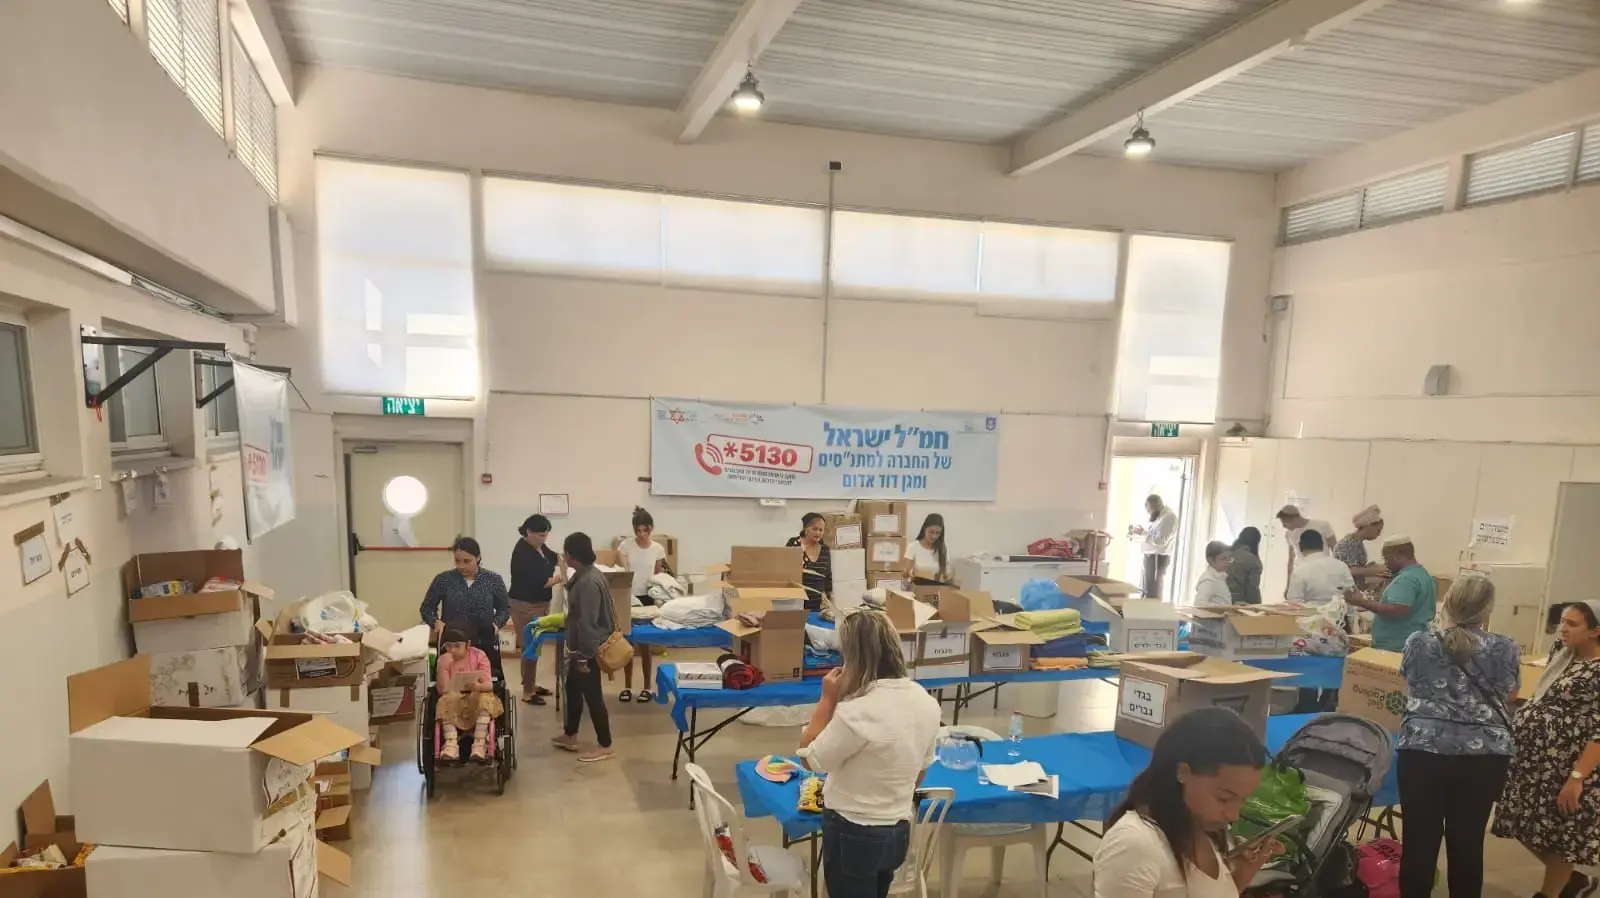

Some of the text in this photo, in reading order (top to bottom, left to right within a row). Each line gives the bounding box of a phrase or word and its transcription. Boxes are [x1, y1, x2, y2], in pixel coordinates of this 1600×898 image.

[386, 397, 420, 414] יציאה
[823, 421, 891, 448] ישראל
[894, 424, 949, 449] חמ"ל
[887, 454, 930, 469] החברה
[934, 451, 952, 469] של
[842, 473, 928, 492] ומגן דוד אדום
[1133, 688, 1152, 702] בגדי
[1129, 703, 1153, 717] גברים
